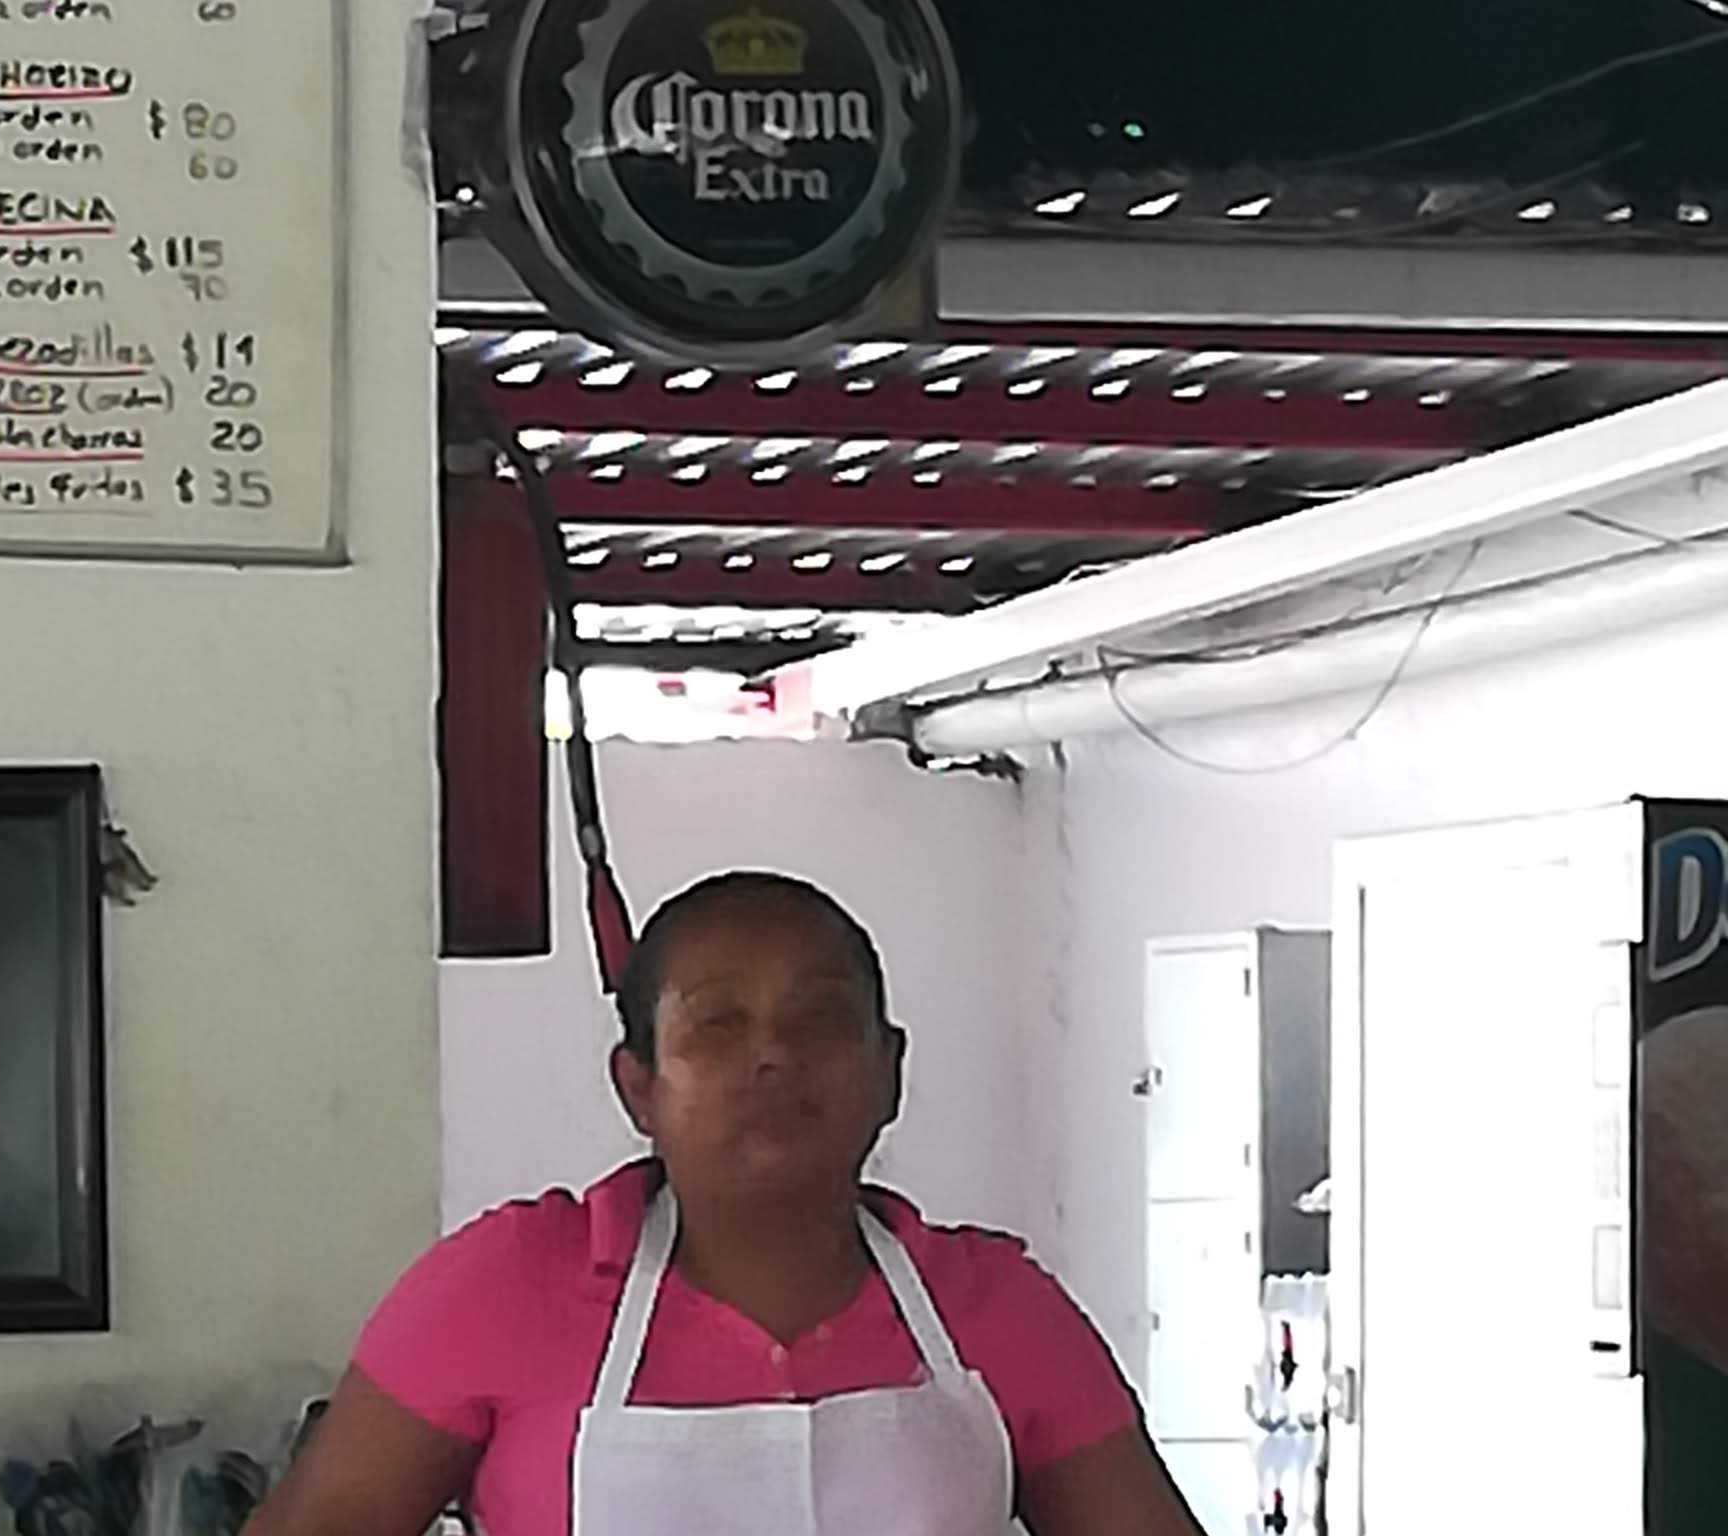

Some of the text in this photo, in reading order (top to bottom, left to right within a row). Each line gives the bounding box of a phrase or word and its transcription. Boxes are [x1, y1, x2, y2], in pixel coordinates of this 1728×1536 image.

[610, 70, 874, 164] Corona
[188, 151, 237, 180] 60
[695, 149, 830, 202] Extra
[6, 273, 105, 300] orden
[181, 272, 228, 302] 70
[205, 375, 257, 407] 20
[211, 422, 263, 452] 20
